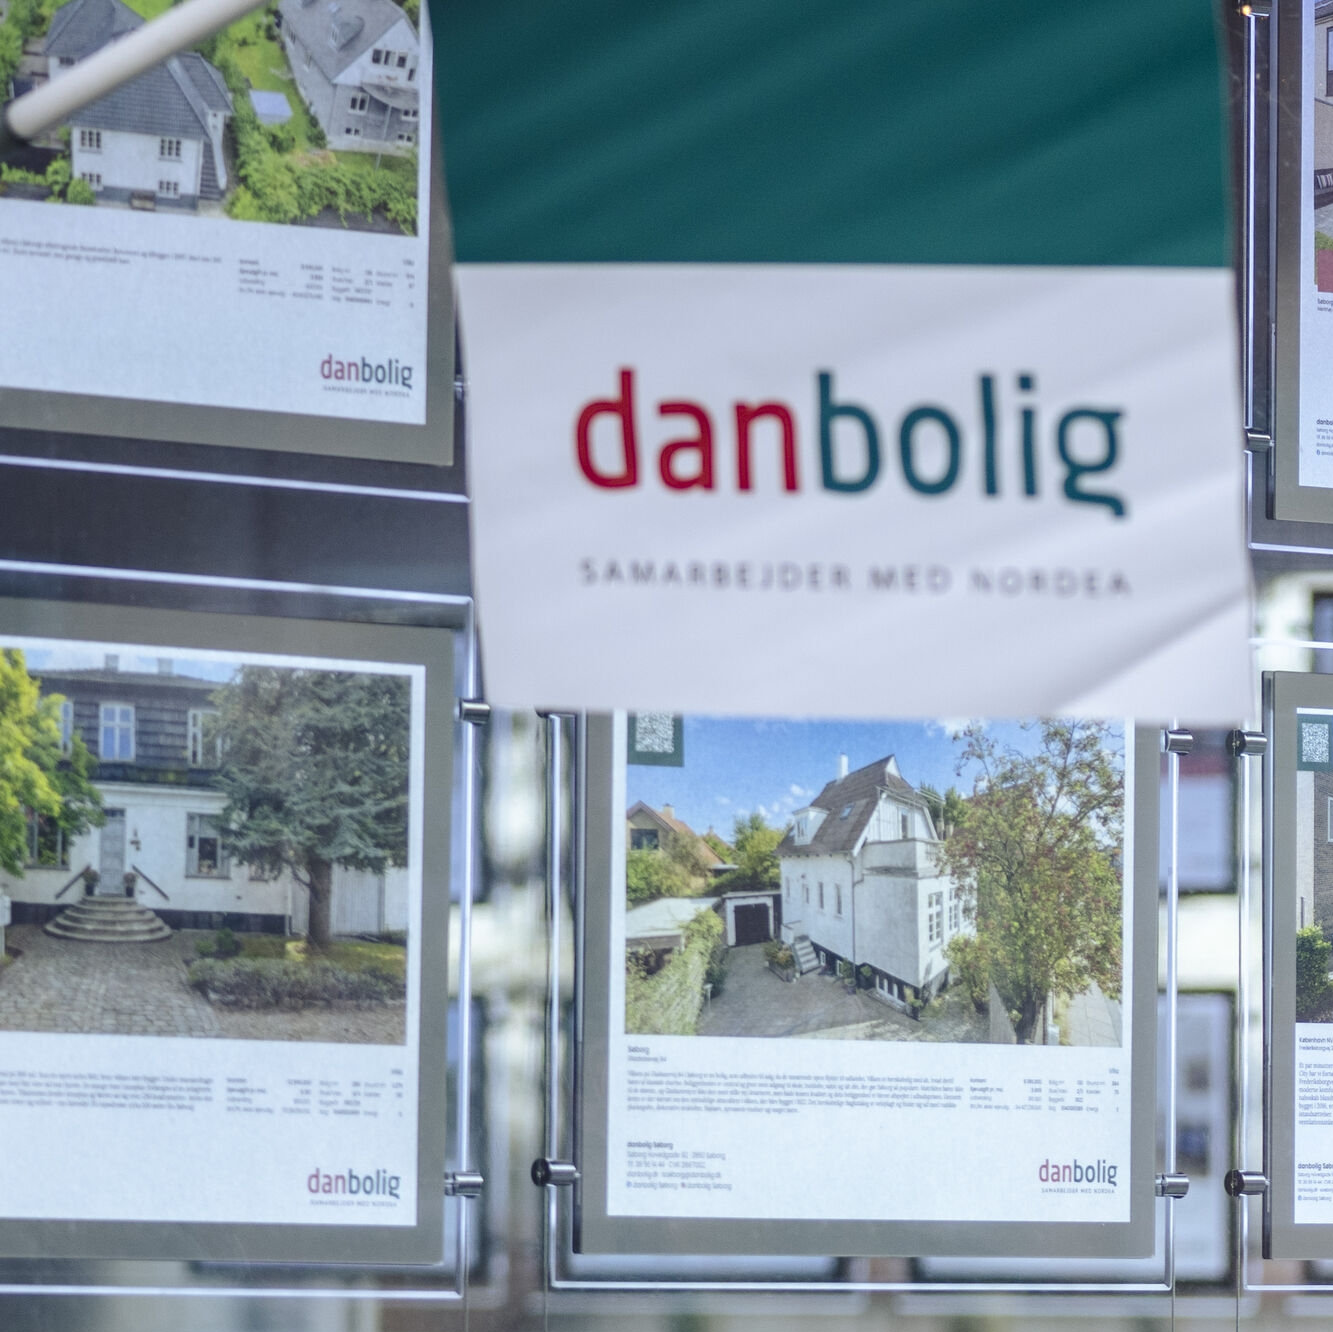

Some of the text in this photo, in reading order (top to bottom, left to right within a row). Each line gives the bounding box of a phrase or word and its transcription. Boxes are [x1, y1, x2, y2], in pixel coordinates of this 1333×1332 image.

[321, 354, 413, 390] danbolig
[575, 366, 1129, 519] danbolig
[579, 559, 1132, 598] SAMARBEJDER MED NORDEA
[308, 1169, 401, 1198] danbolig
[1039, 1159, 1118, 1186] danbolig
